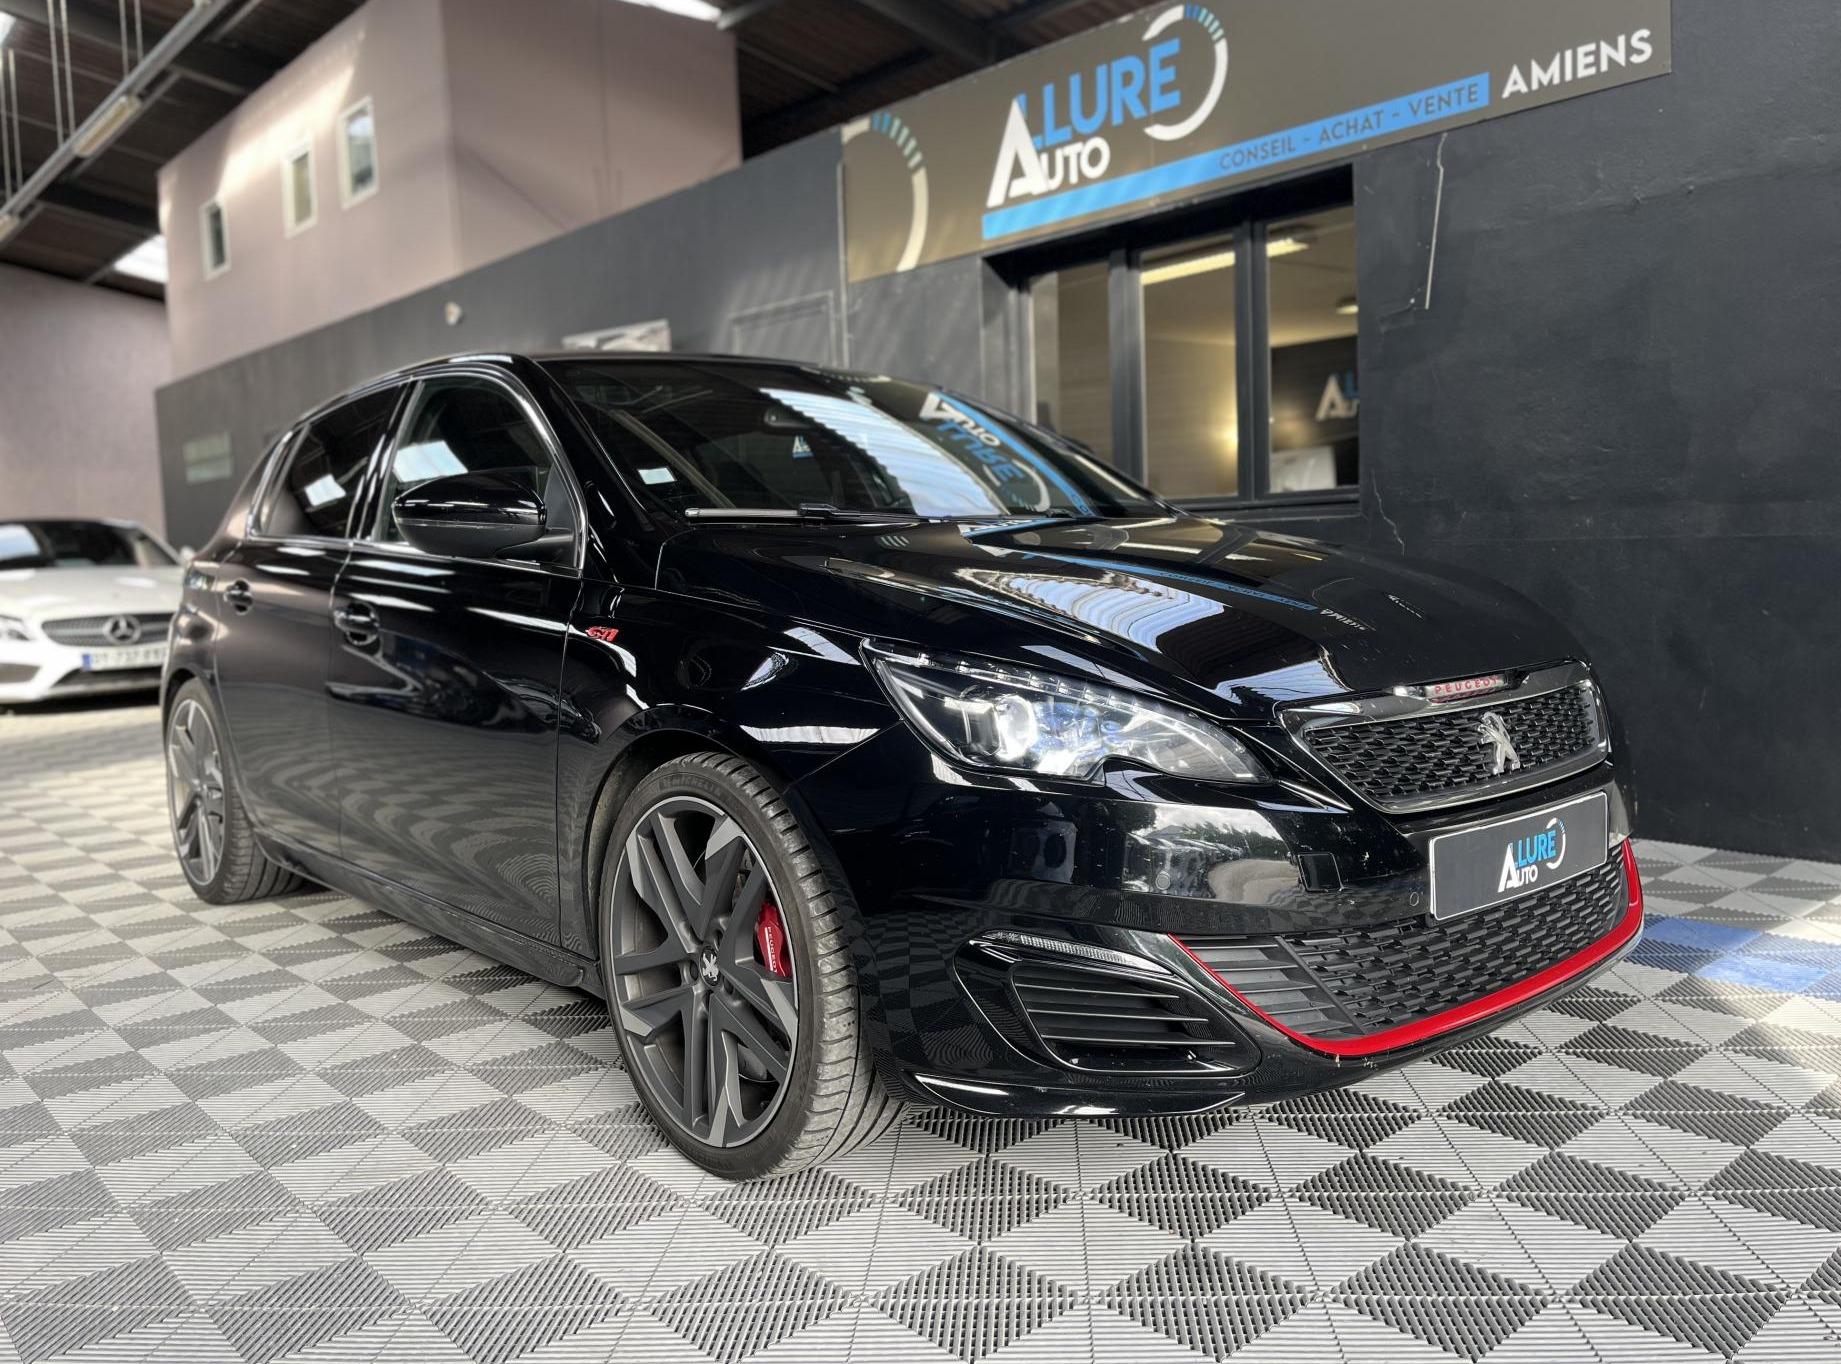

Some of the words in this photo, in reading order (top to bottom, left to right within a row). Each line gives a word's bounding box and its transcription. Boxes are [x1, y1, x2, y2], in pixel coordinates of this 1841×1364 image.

[1501, 28, 1653, 99] AMIENS
[987, 98, 1111, 208] AUTO
[1219, 136, 1296, 170] CONSEIL
[1319, 110, 1383, 145] ACHAT
[1408, 83, 1479, 117] VENTE
[1434, 674, 1500, 695] PEUGEOT
[1498, 843, 1538, 892] AUTO
